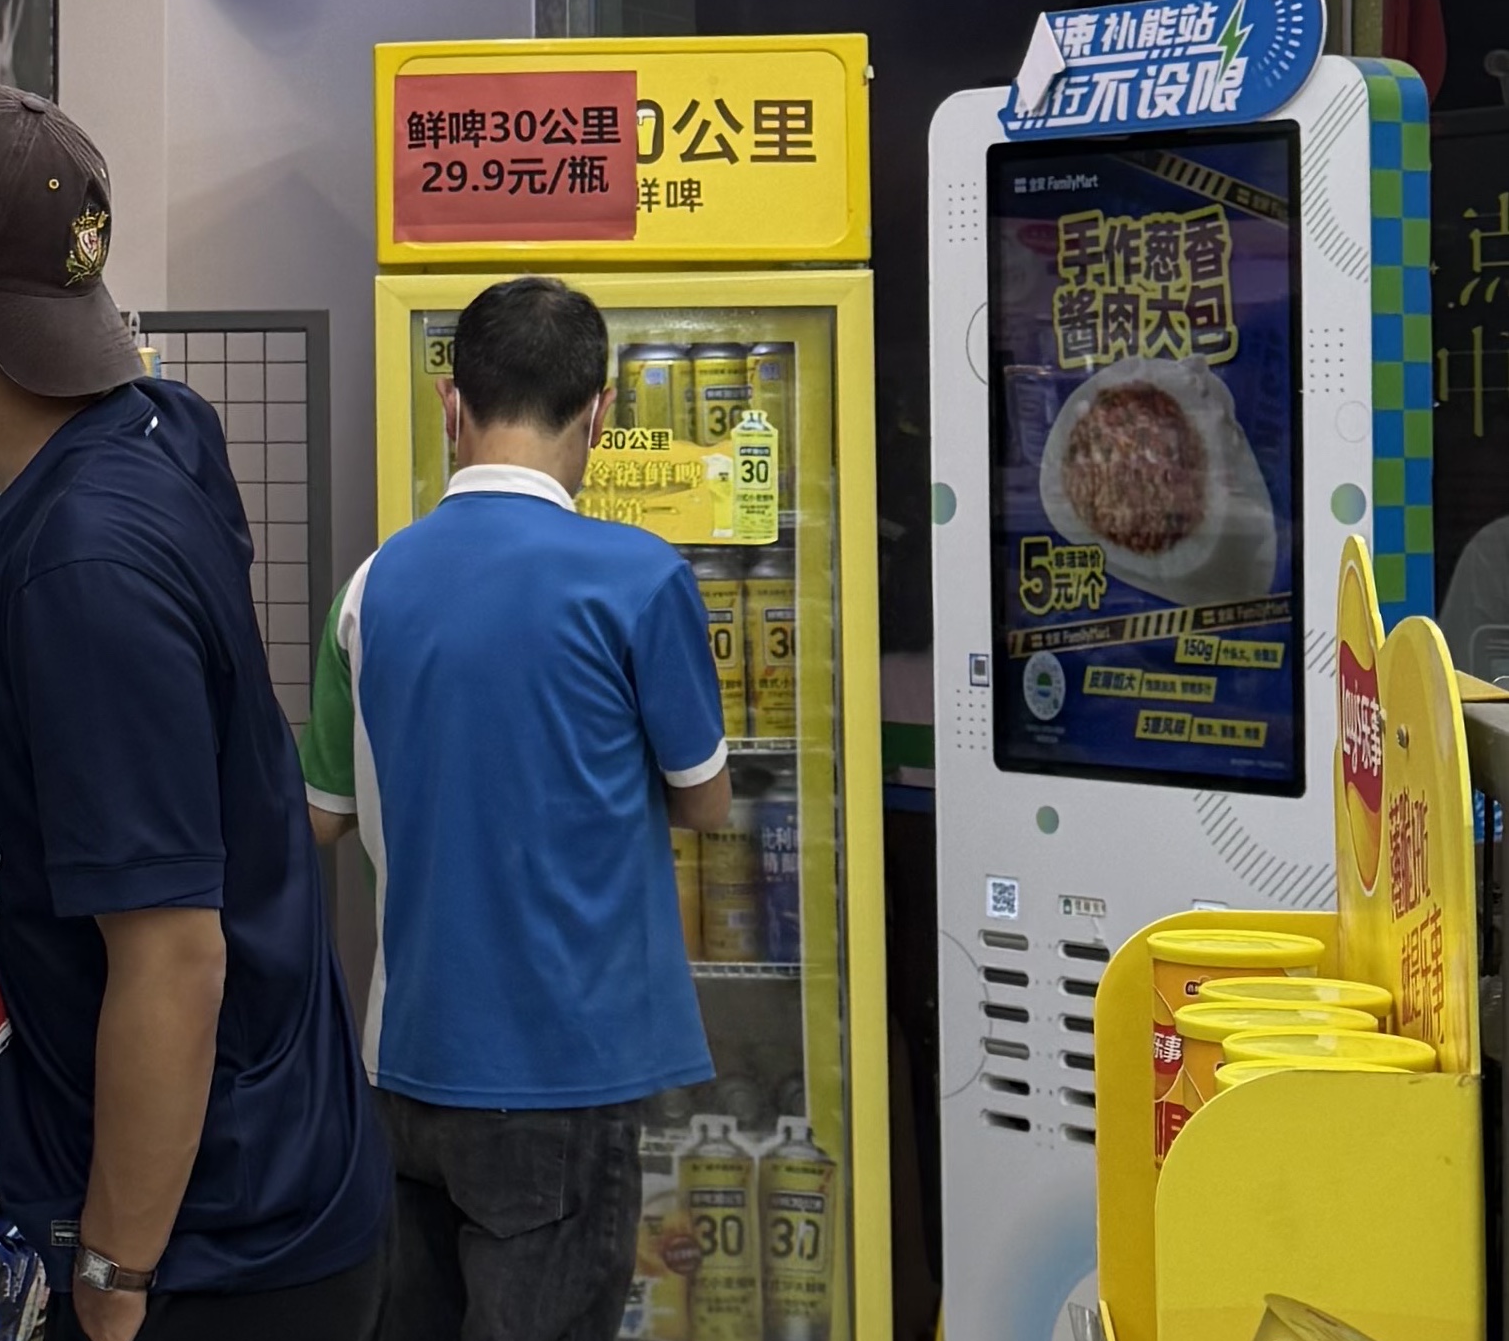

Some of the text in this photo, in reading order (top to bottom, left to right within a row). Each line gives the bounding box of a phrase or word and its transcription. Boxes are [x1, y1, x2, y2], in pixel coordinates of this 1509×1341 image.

[406, 105, 621, 151] 鲜啤30公里
[421, 156, 609, 196] 29.9元/瓶
[1046, 174, 1099, 195] FamilyMart
[1059, 211, 1231, 286] 手作葱香
[1056, 286, 1234, 360] 酱肉大包
[602, 429, 671, 452] 30公里
[741, 459, 770, 484] 30
[1022, 537, 1054, 613] 5
[1053, 570, 1106, 608] 元/个
[1183, 638, 1214, 661] 150g
[697, 1215, 745, 1257] 30
